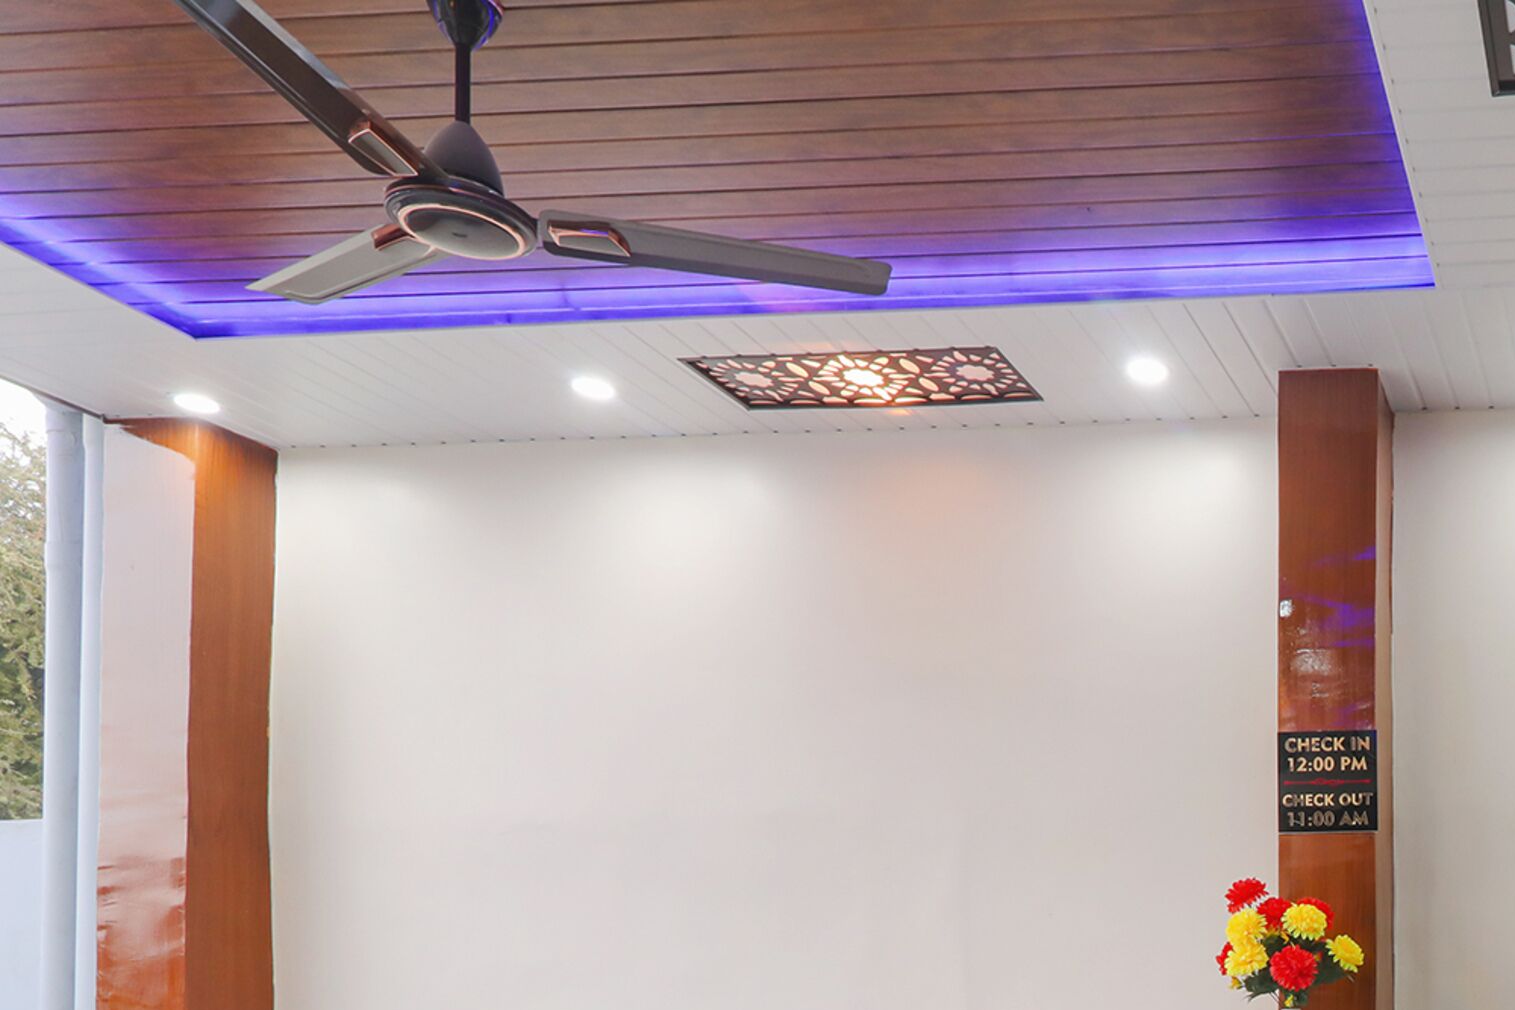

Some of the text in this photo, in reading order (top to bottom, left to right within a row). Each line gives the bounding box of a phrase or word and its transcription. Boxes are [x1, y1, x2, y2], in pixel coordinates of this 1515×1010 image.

[1284, 736, 1370, 753] CHECK IN
[1287, 756, 1367, 772] 12:00 PM
[1282, 792, 1373, 807] CHECK OUT
[1287, 811, 1369, 827] 11:00 AM
